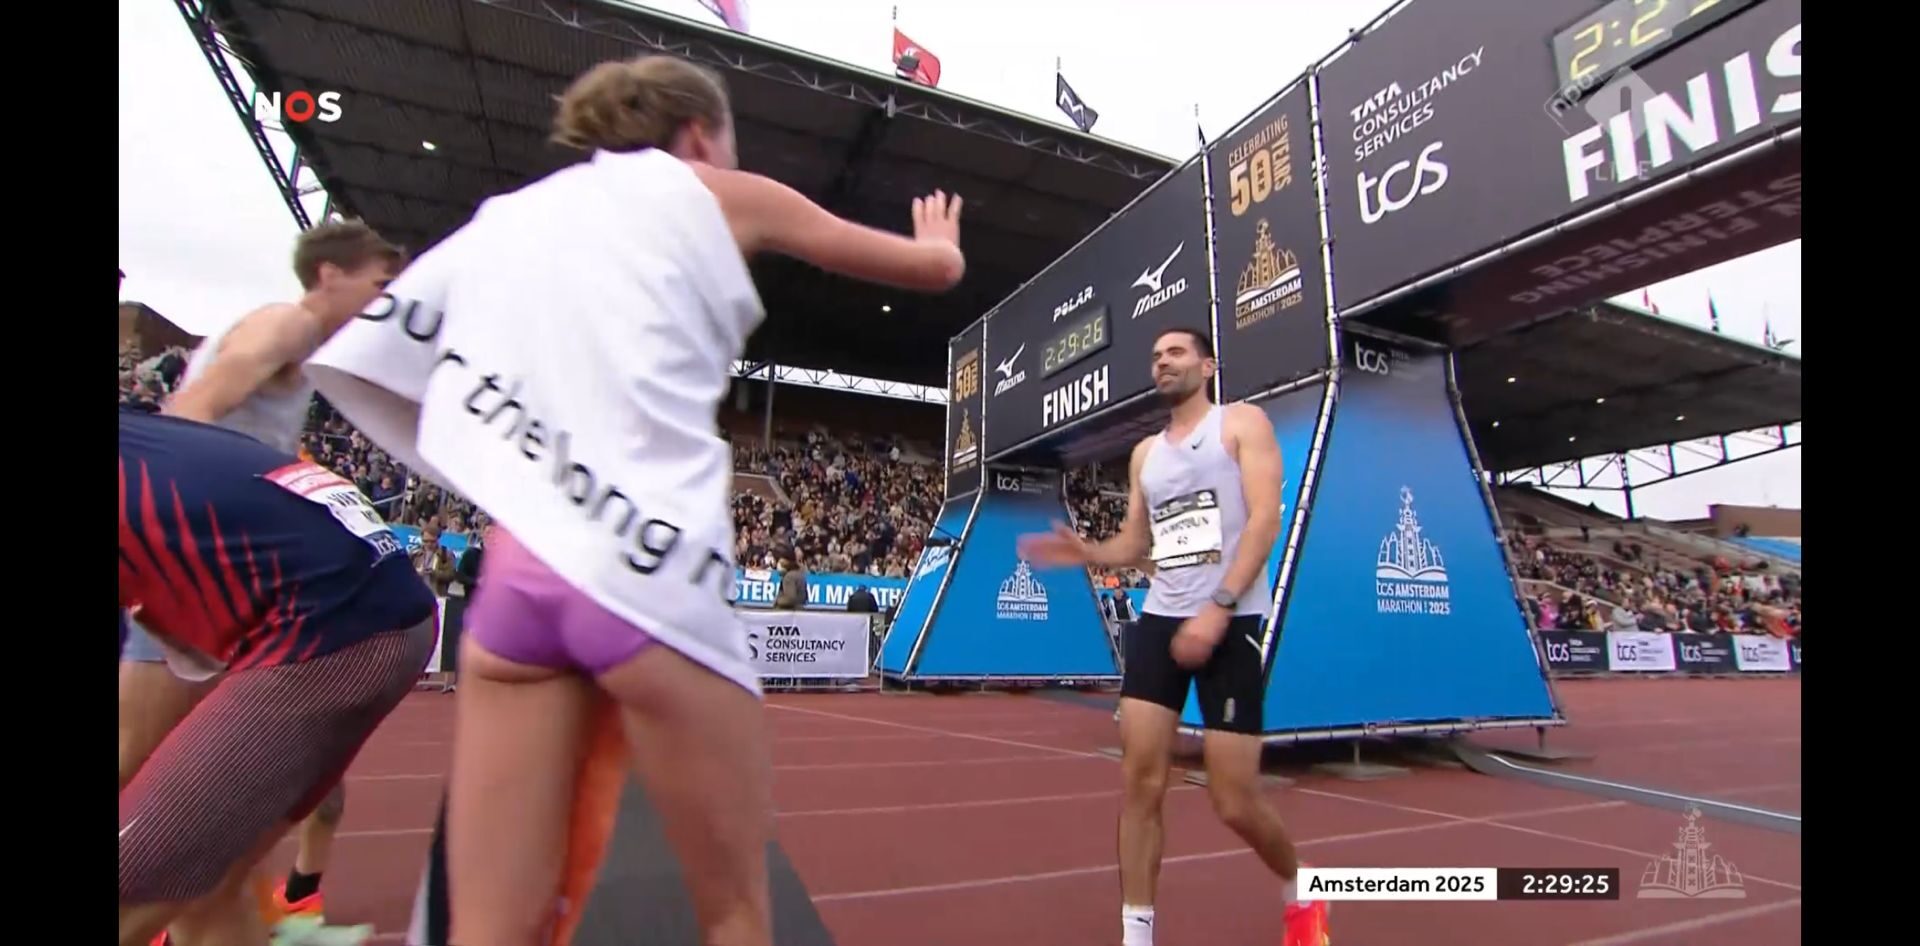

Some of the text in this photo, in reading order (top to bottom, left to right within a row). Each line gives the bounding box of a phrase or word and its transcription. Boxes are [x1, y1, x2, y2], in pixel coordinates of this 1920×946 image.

[1351, 81, 1402, 123] TATA
[1352, 45, 1485, 142] CONSULTANCY
[1228, 113, 1289, 169] CELEBRATING
[1354, 102, 1435, 163] SERVICES
[1271, 131, 1293, 192] YEARS
[1229, 149, 1273, 217] 50
[1053, 285, 1095, 323] POLAR
[1235, 291, 1304, 331] MARATHON 2025
[1250, 277, 1303, 312] AMSTERDAM
[1042, 363, 1110, 429] FINISH
[551, 430, 685, 576] long
[1010, 602, 1049, 613] AMSTERDAM
[1377, 598, 1451, 615] MARATHON 2025
[1395, 582, 1450, 599] AMSTERDAM
[765, 639, 846, 652] CONSULTANCY
[767, 625, 801, 637] TATA
[765, 652, 817, 663] SERVICES
